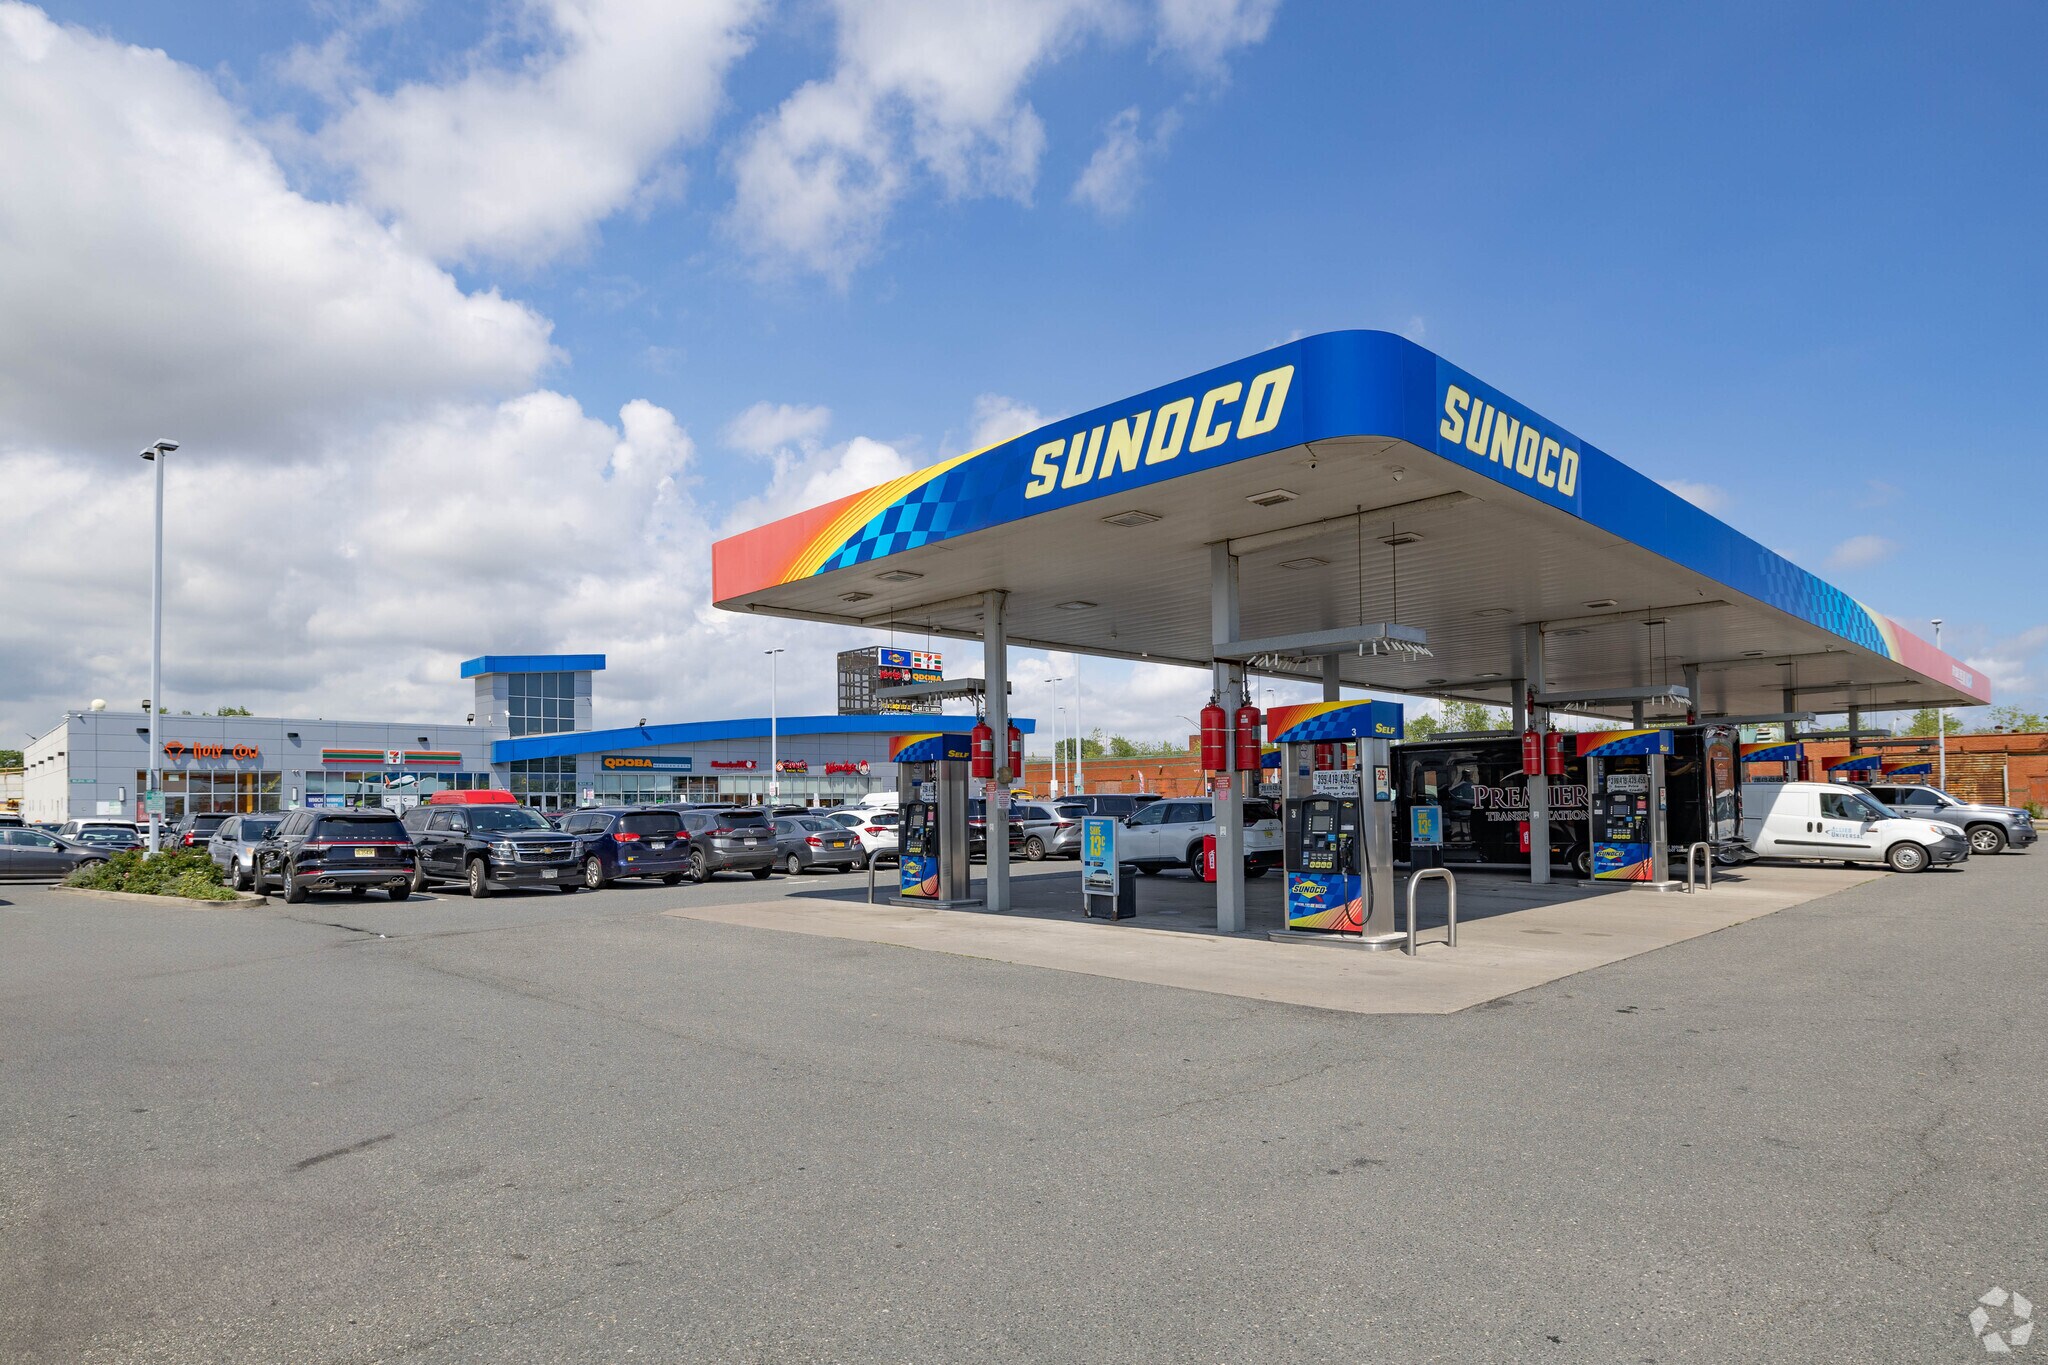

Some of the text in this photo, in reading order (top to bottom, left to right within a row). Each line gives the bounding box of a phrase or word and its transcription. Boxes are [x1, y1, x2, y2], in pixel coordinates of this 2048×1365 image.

[1024, 364, 1296, 500] SUNOCO
[1439, 383, 1580, 498] SUNOCO
[912, 673, 942, 682] QDOBA
[1351, 728, 1357, 737] 3
[1375, 723, 1396, 735] SELF
[193, 741, 259, 761] HOLY COW
[947, 750, 969, 758] SELF
[604, 758, 653, 769] QDOBA
[1471, 784, 1589, 809] PREIER
[1291, 809, 1296, 819] 3
[1831, 832, 1864, 840] UNIVERSAL
[1293, 886, 1326, 894] SUNOCO
